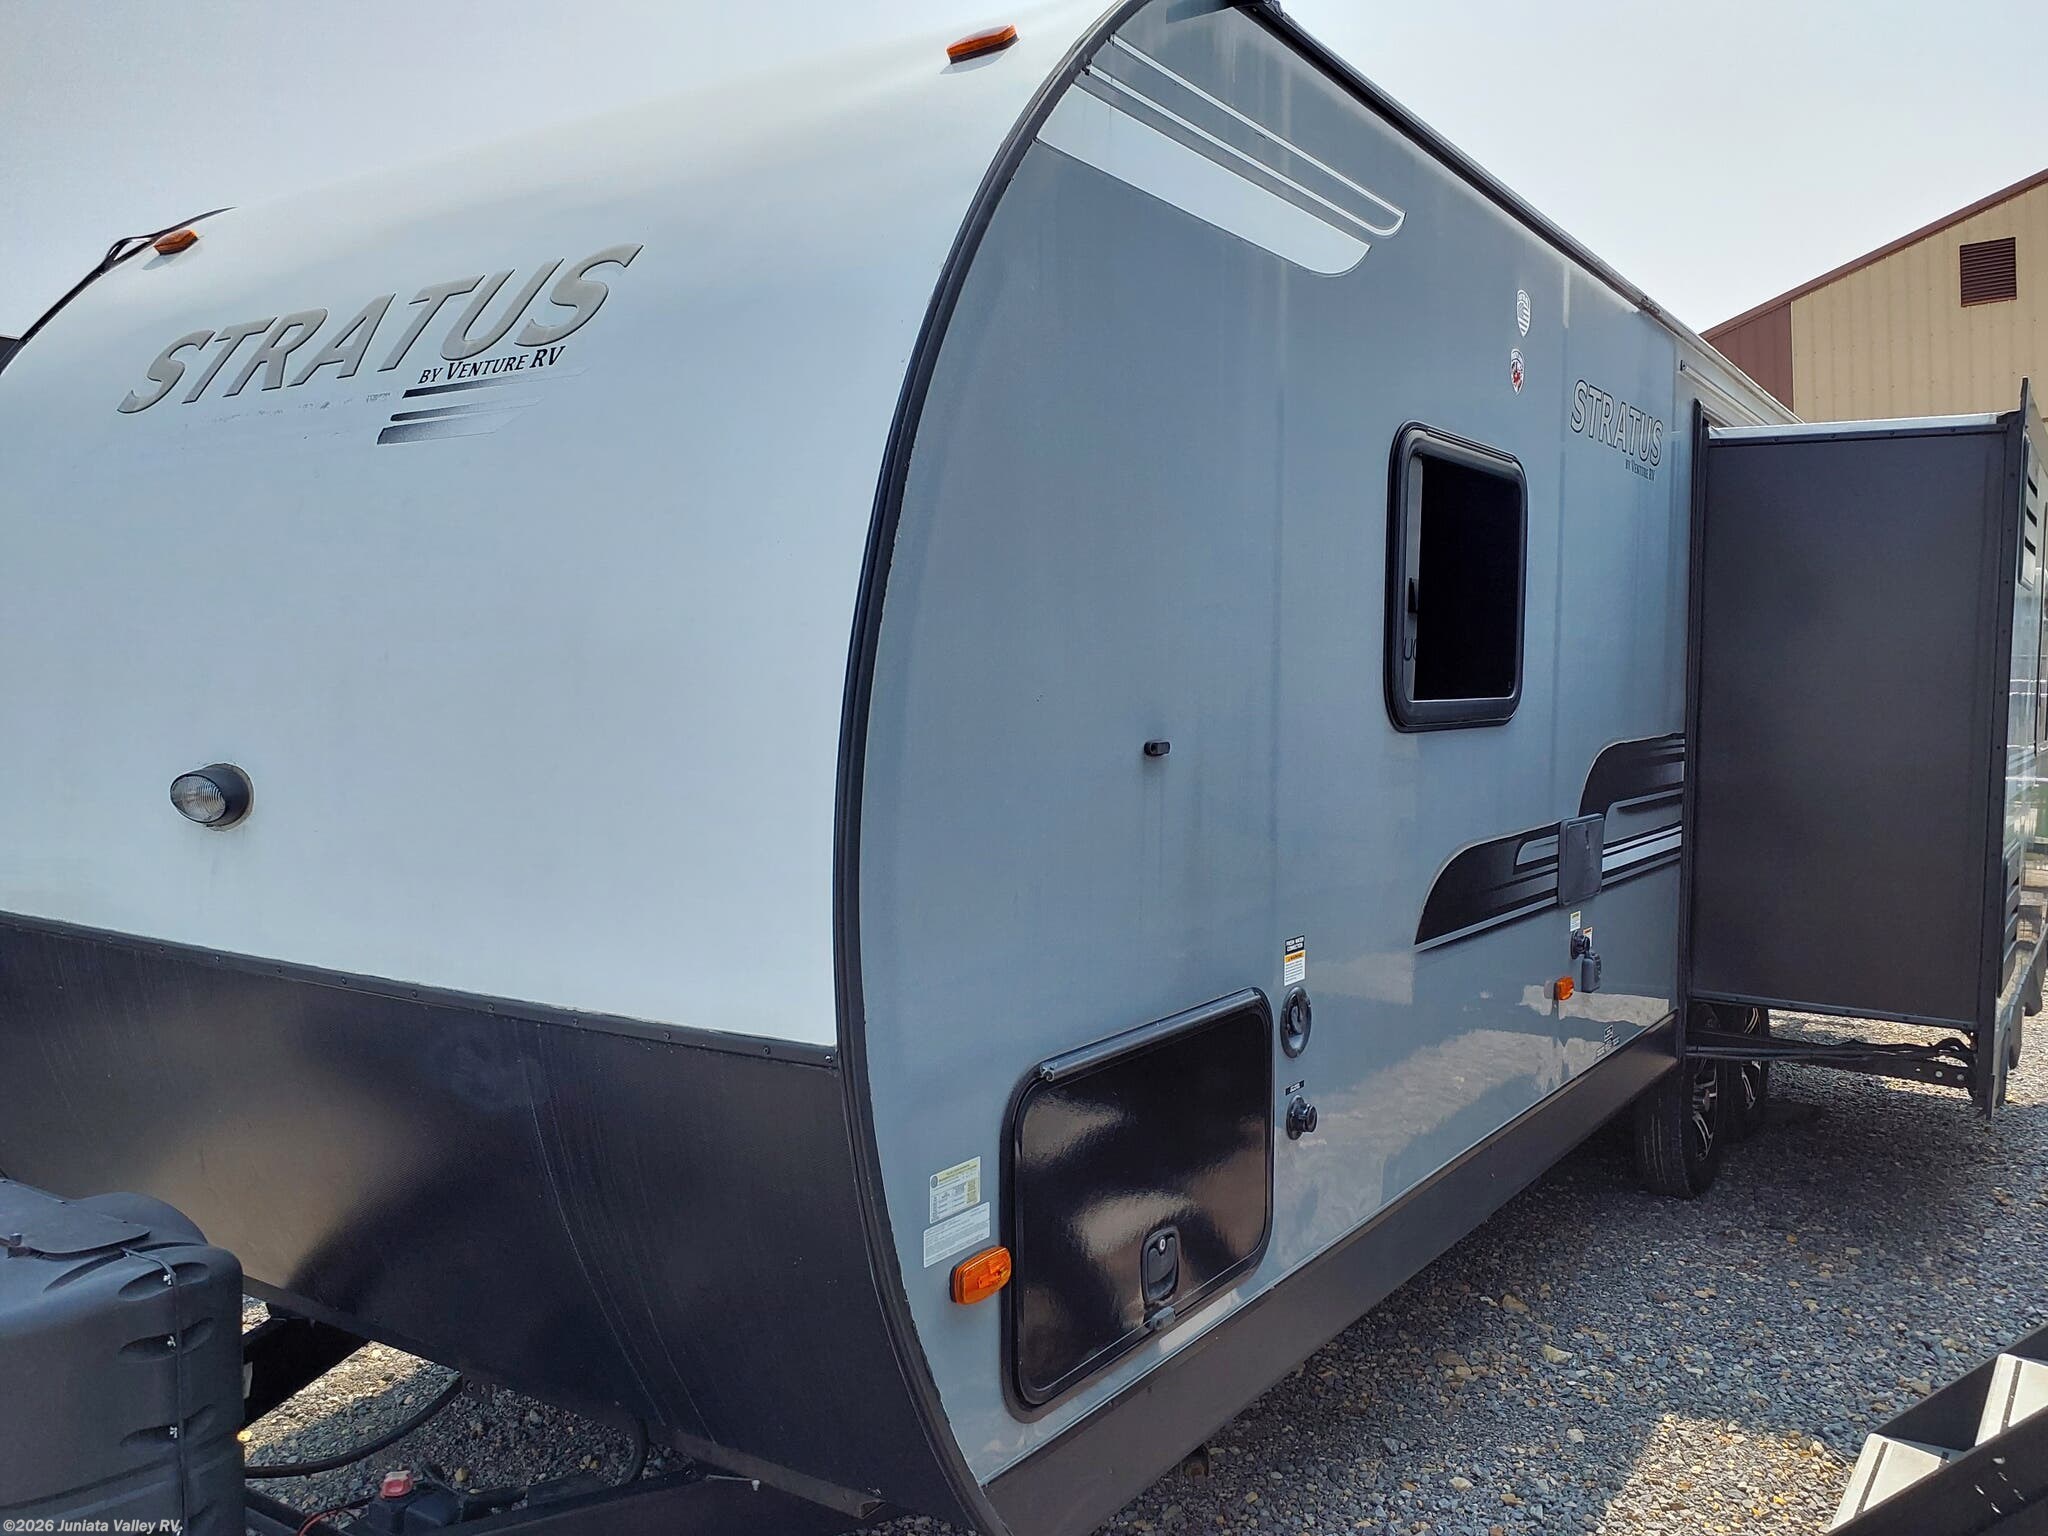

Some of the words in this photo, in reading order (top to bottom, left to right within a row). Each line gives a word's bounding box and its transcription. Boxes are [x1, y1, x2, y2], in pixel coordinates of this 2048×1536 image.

[117, 243, 644, 413] STRATUS
[418, 367, 443, 384] BY
[446, 354, 530, 380] VENTURE
[529, 345, 566, 369] RV
[1570, 379, 1664, 466] STRATUS
